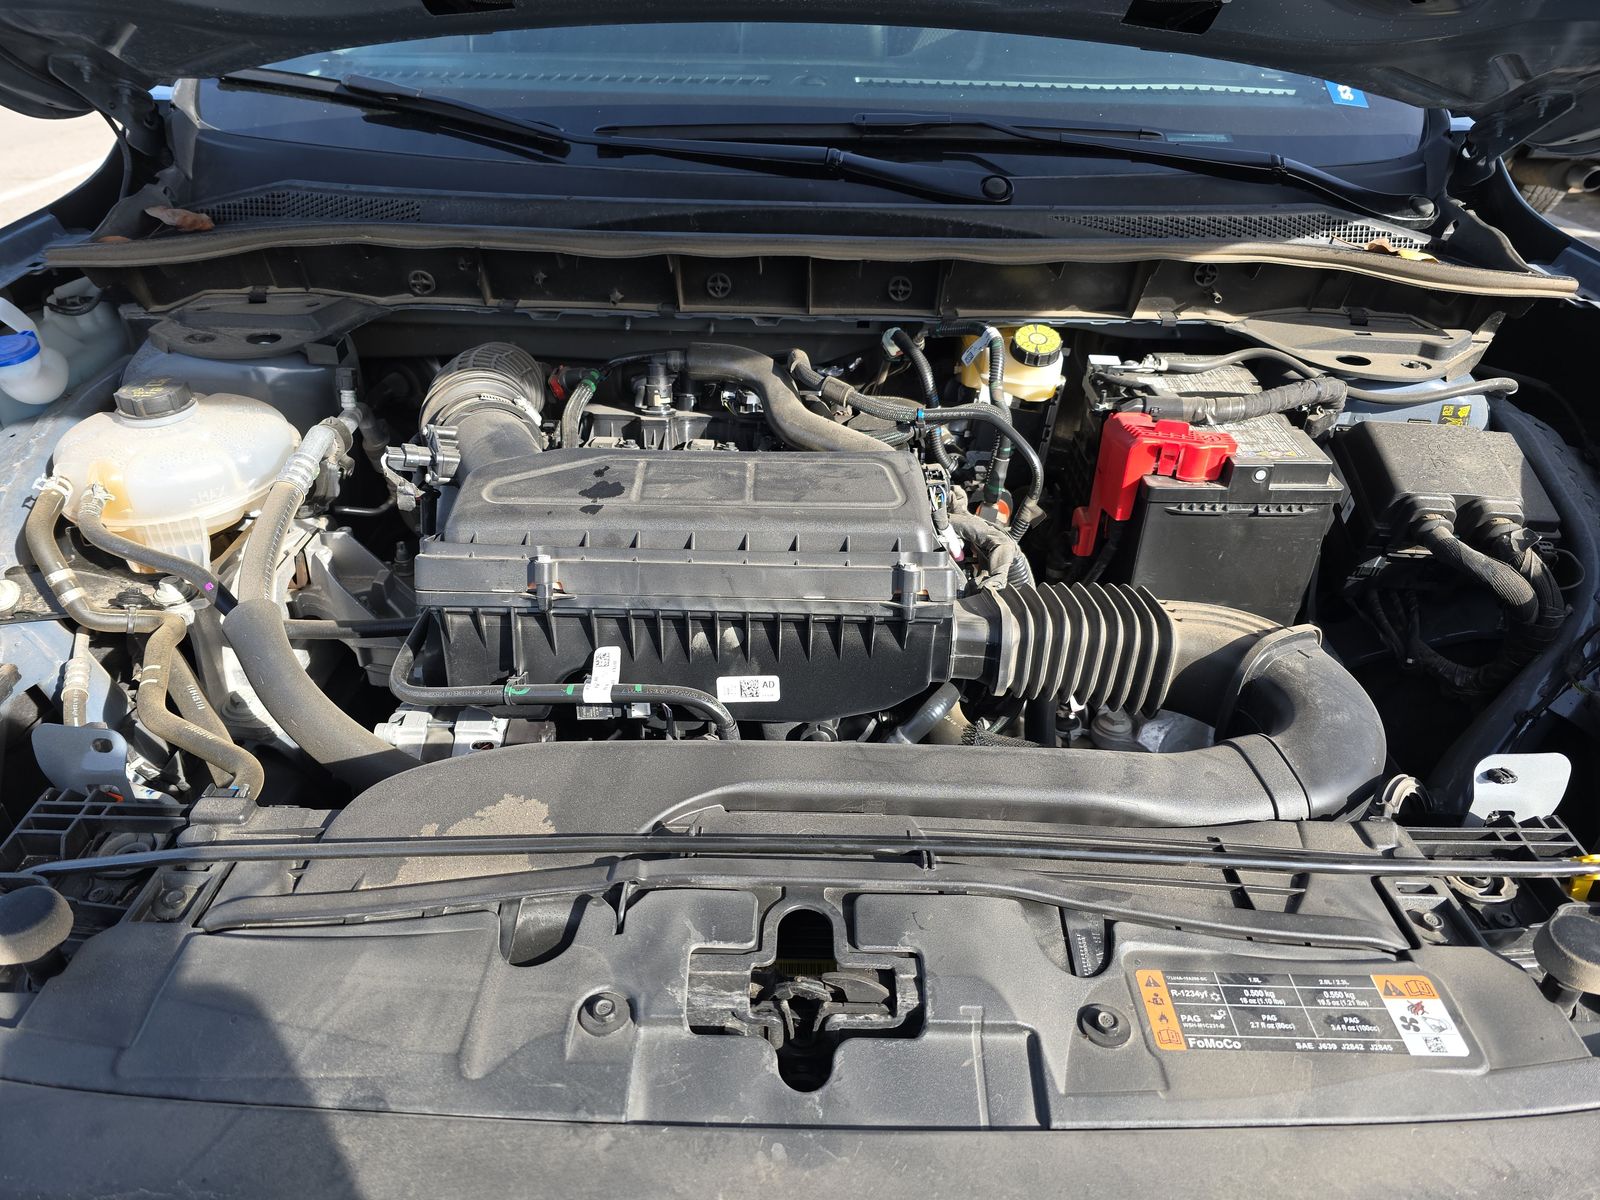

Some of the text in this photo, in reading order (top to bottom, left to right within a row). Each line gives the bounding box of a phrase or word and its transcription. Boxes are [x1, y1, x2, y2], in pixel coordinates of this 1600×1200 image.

[762, 680, 775, 688] AD
[1170, 989, 1208, 999] R-1234yf
[1264, 989, 1276, 999] kg
[1344, 990, 1356, 1001] kg
[1180, 1014, 1202, 1023] PAG
[1261, 1014, 1278, 1022] PAG
[1342, 1016, 1360, 1024] PAG
[1187, 1038, 1242, 1050] FoMoCo
